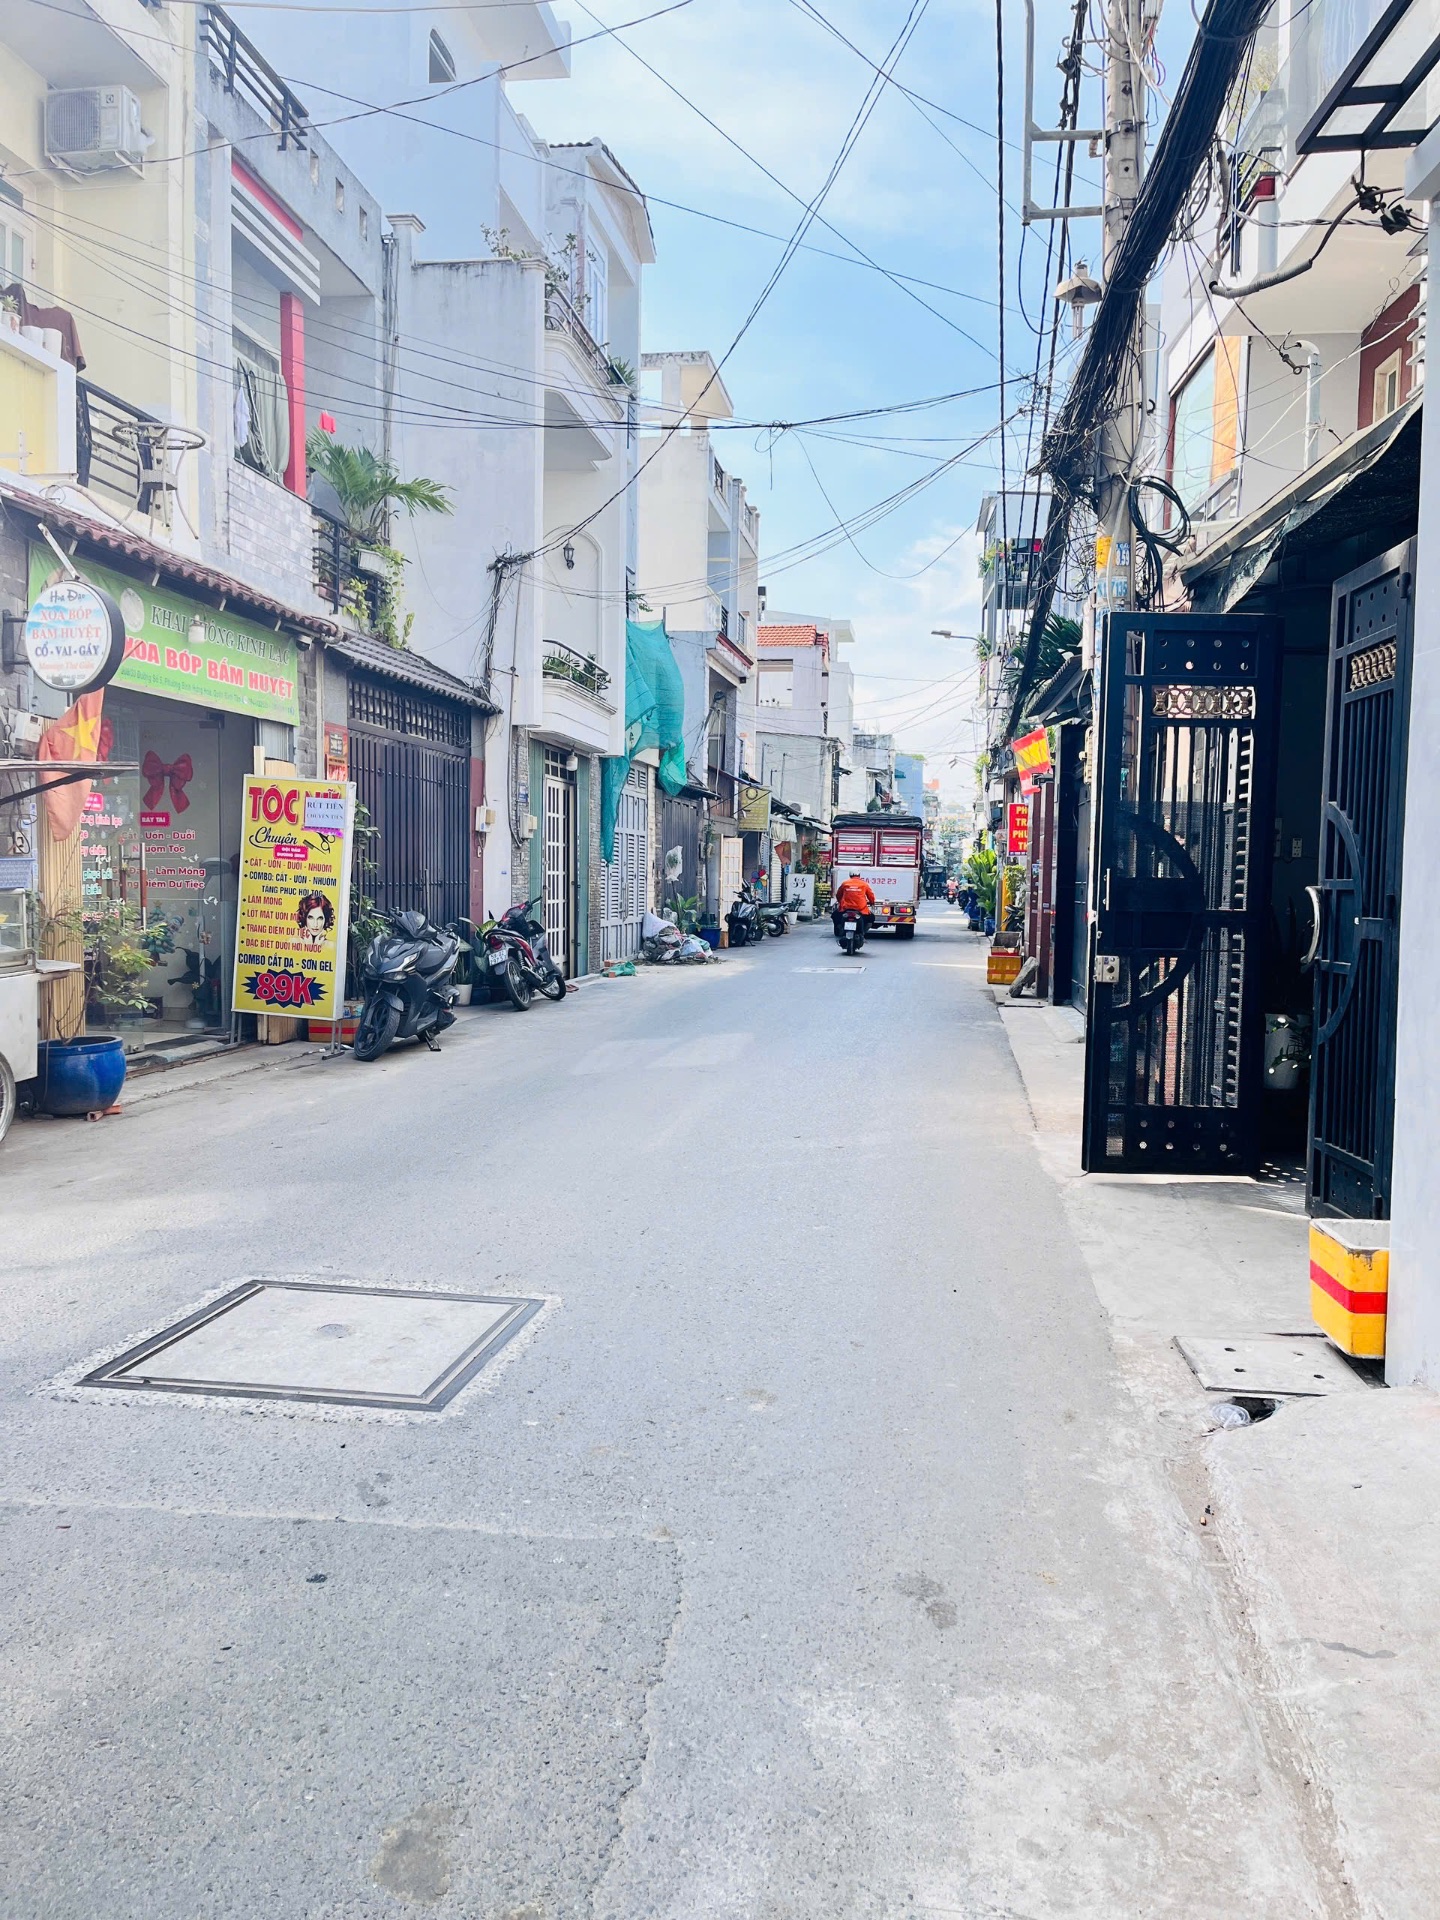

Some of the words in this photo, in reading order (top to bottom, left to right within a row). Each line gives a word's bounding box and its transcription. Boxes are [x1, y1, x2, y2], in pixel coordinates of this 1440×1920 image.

[41, 609, 65, 621] XOA
[68, 606, 92, 619] BÓP
[151, 605, 187, 634] KHAI
[237, 634, 267, 659] KINH
[269, 644, 290, 666] LẠC
[35, 641, 49, 657] CỔ
[55, 646, 72, 656] VAI
[78, 643, 100, 656] GÁY
[165, 645, 202, 675] BÓP
[207, 657, 244, 687] BẤM
[248, 671, 295, 699] HUYỆT
[248, 784, 299, 824] TÓC
[249, 826, 298, 848] Chuyên
[246, 923, 267, 934] TRANG
[238, 953, 266, 966] COMBO
[267, 952, 282, 968] CẮT
[284, 958, 294, 969] DA
[301, 959, 318, 971] SƠN
[319, 960, 334, 972] GEL
[256, 972, 314, 1005] 89K
